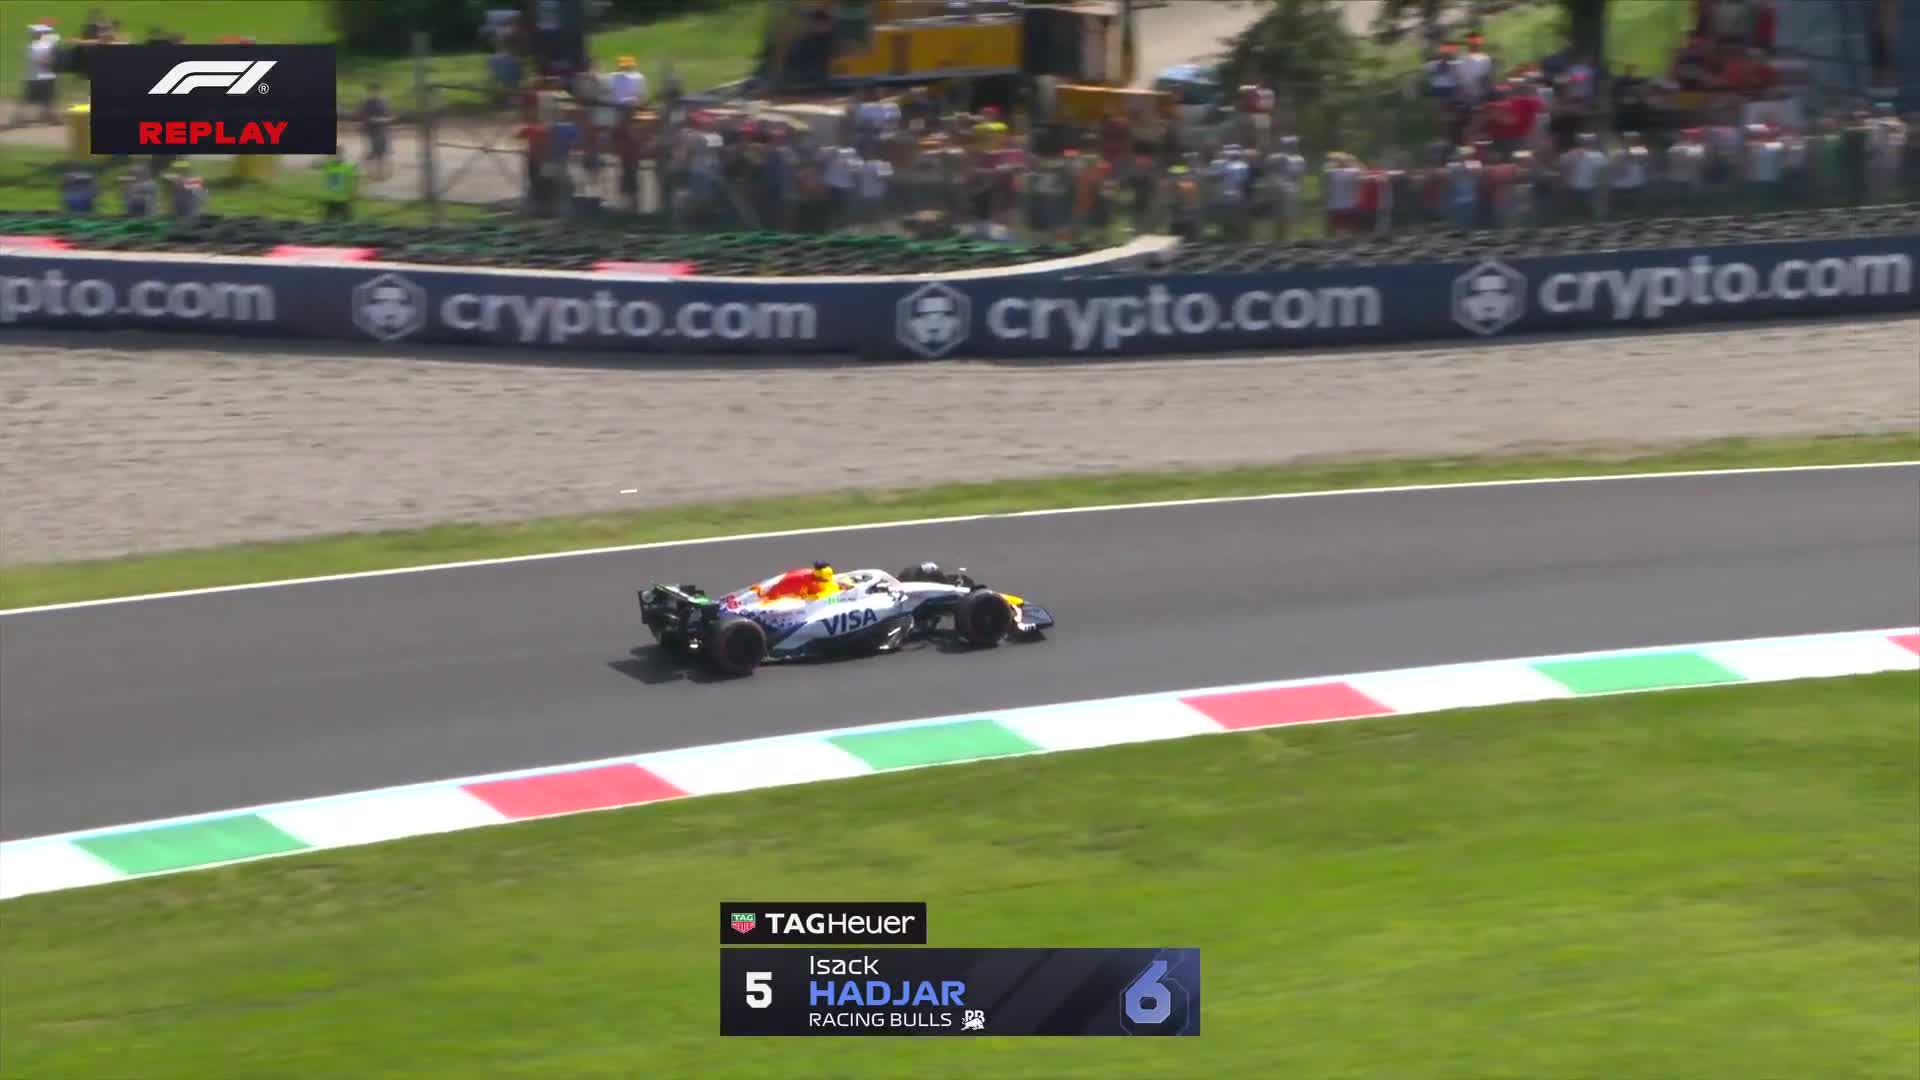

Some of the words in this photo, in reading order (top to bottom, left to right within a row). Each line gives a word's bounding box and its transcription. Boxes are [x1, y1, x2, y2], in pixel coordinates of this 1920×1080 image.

[1537, 253, 1912, 320] crypto.com
[440, 291, 818, 343] crypto.com
[986, 284, 1382, 350] crypto.com
[821, 608, 878, 636] VISA
